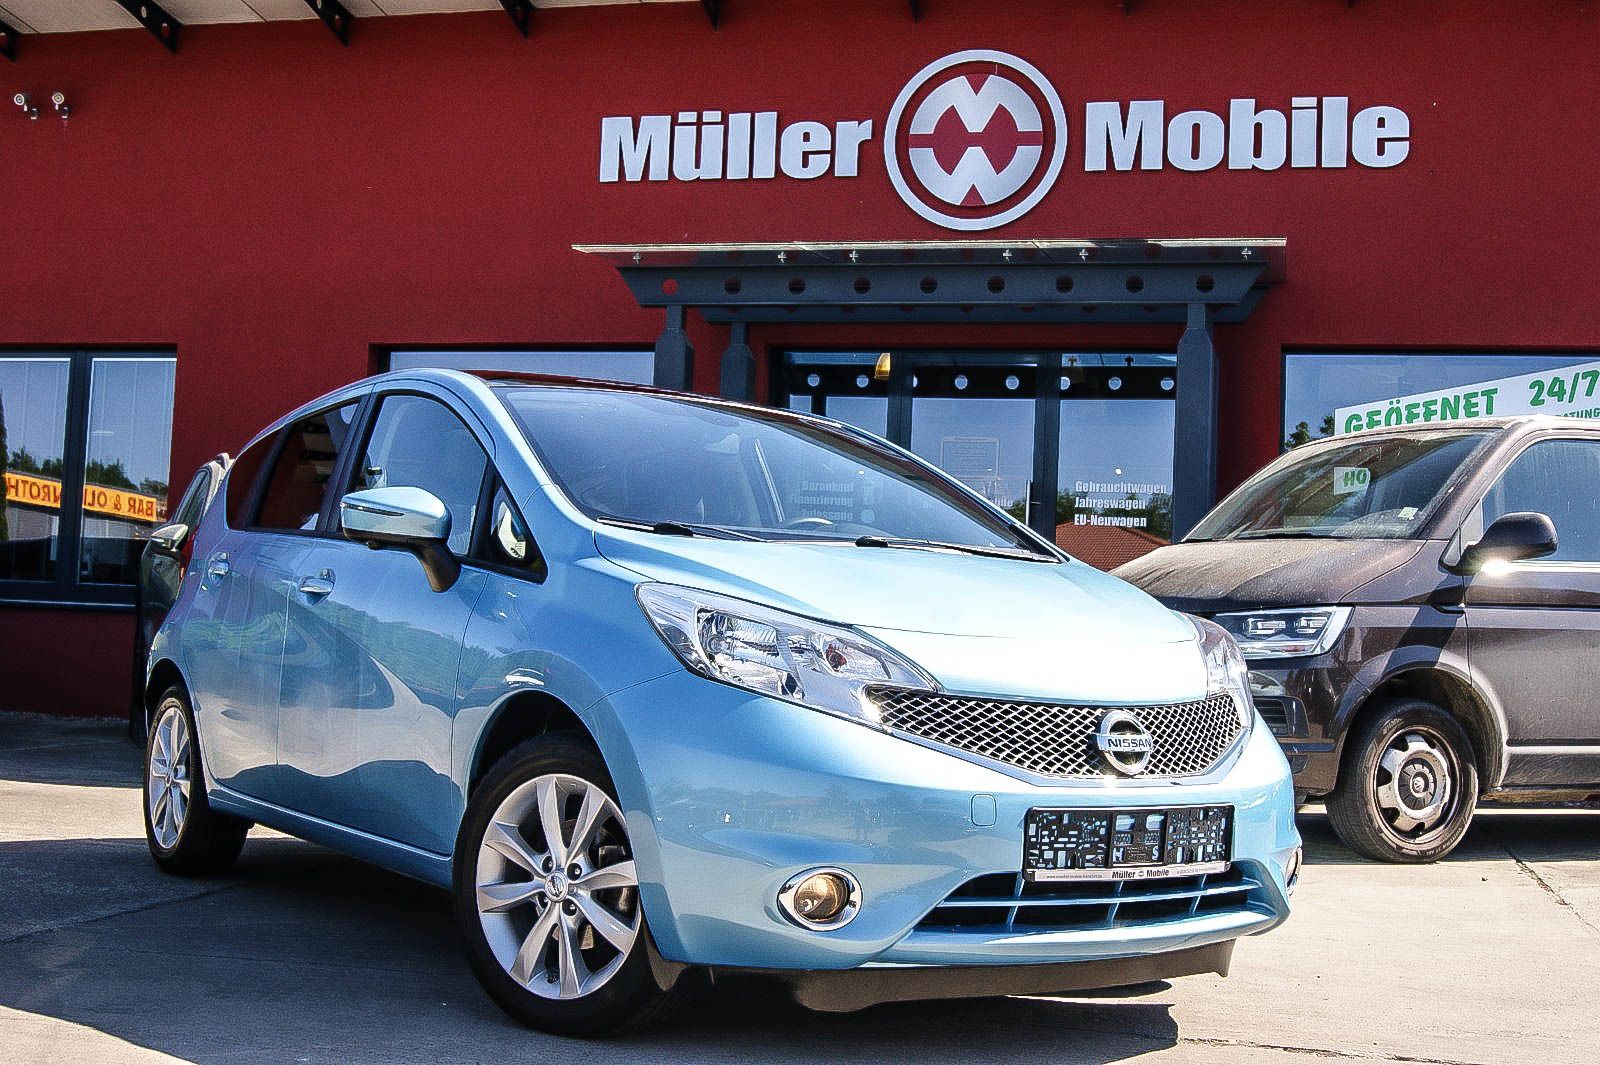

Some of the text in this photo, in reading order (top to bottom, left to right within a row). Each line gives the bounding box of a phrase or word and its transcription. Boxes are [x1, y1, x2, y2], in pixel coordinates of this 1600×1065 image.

[600, 96, 1410, 182] Müller Mobile
[1345, 369, 1600, 434] GEÖFFNET 24/7
[1075, 481, 1168, 494] Gebrauchtwagen
[1074, 496, 1146, 510] Jahreswagen
[1074, 513, 1147, 527] EU-Neuwagen
[1107, 738, 1152, 748] NISSAN
[1112, 870, 1136, 879] Müller
[1146, 869, 1170, 878] Mobile
